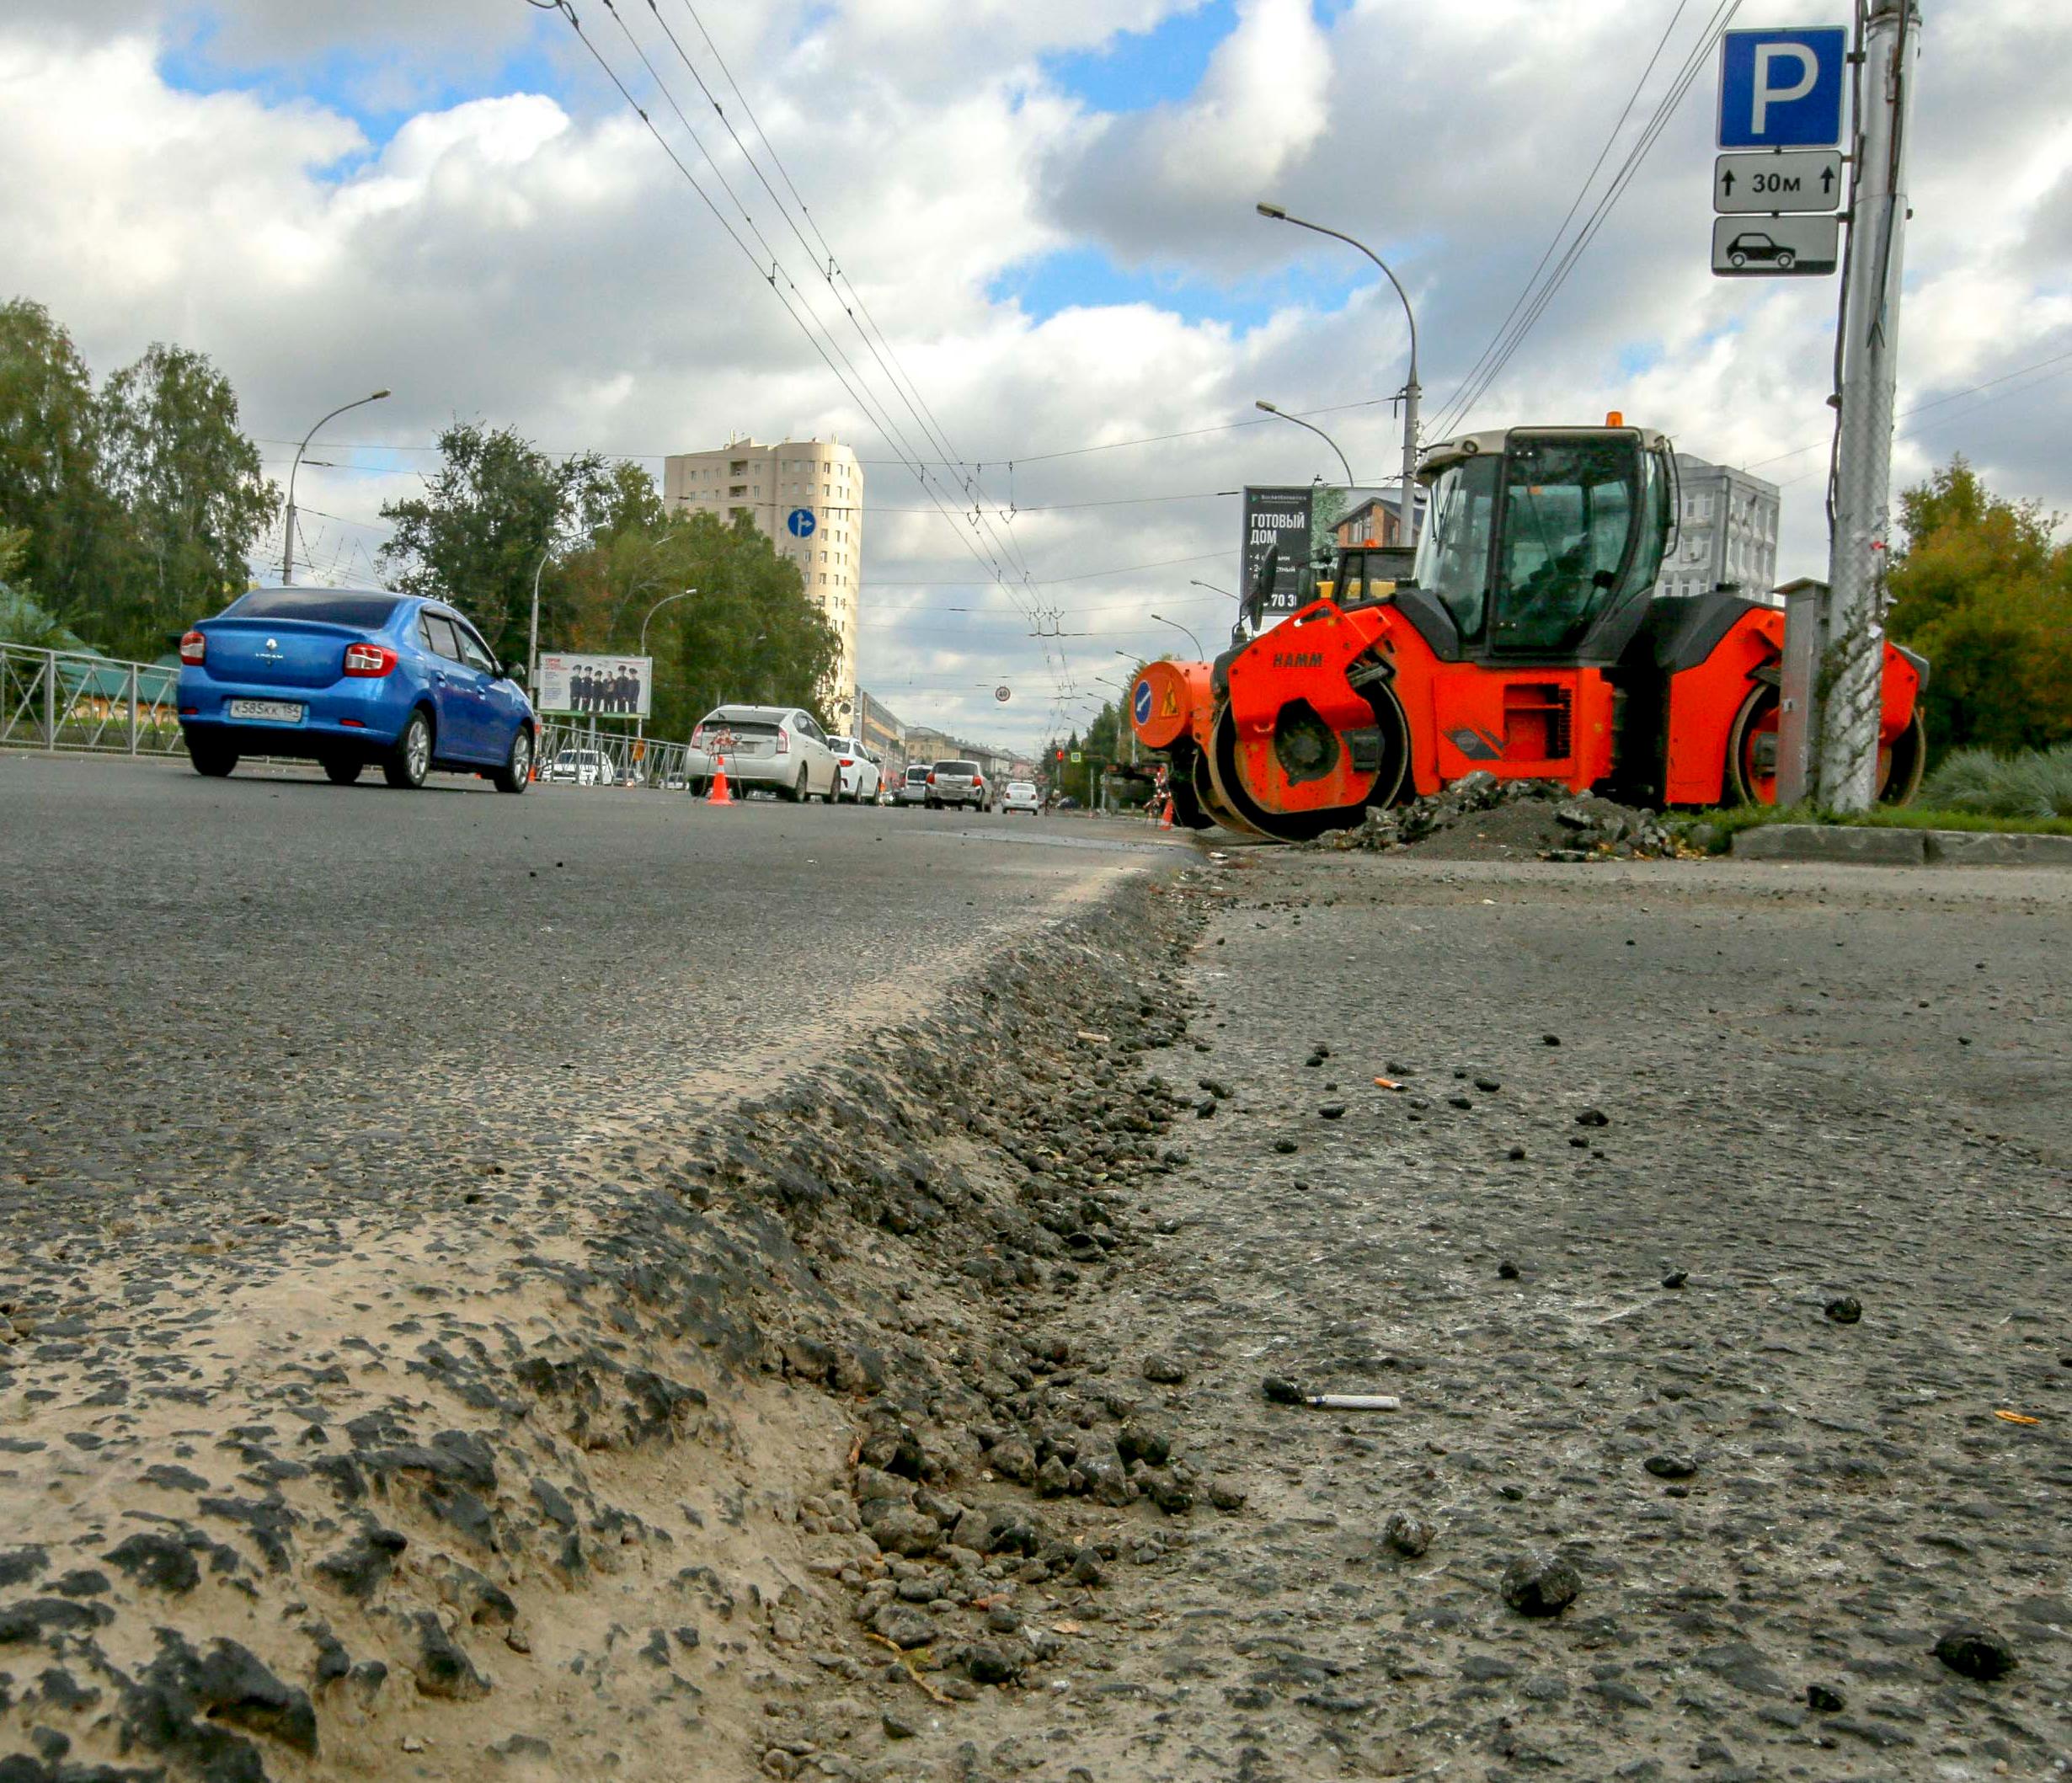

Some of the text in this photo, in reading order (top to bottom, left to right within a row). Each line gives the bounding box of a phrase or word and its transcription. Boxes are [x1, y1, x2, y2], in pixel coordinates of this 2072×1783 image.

[1750, 42, 1819, 135] P
[1752, 173, 1801, 193] 30м
[1251, 511, 1305, 529] ГОТОВЫЙ
[1250, 530, 1277, 546] ДОМ
[1271, 594, 1284, 606] 70
[1274, 653, 1323, 667] HAMM
